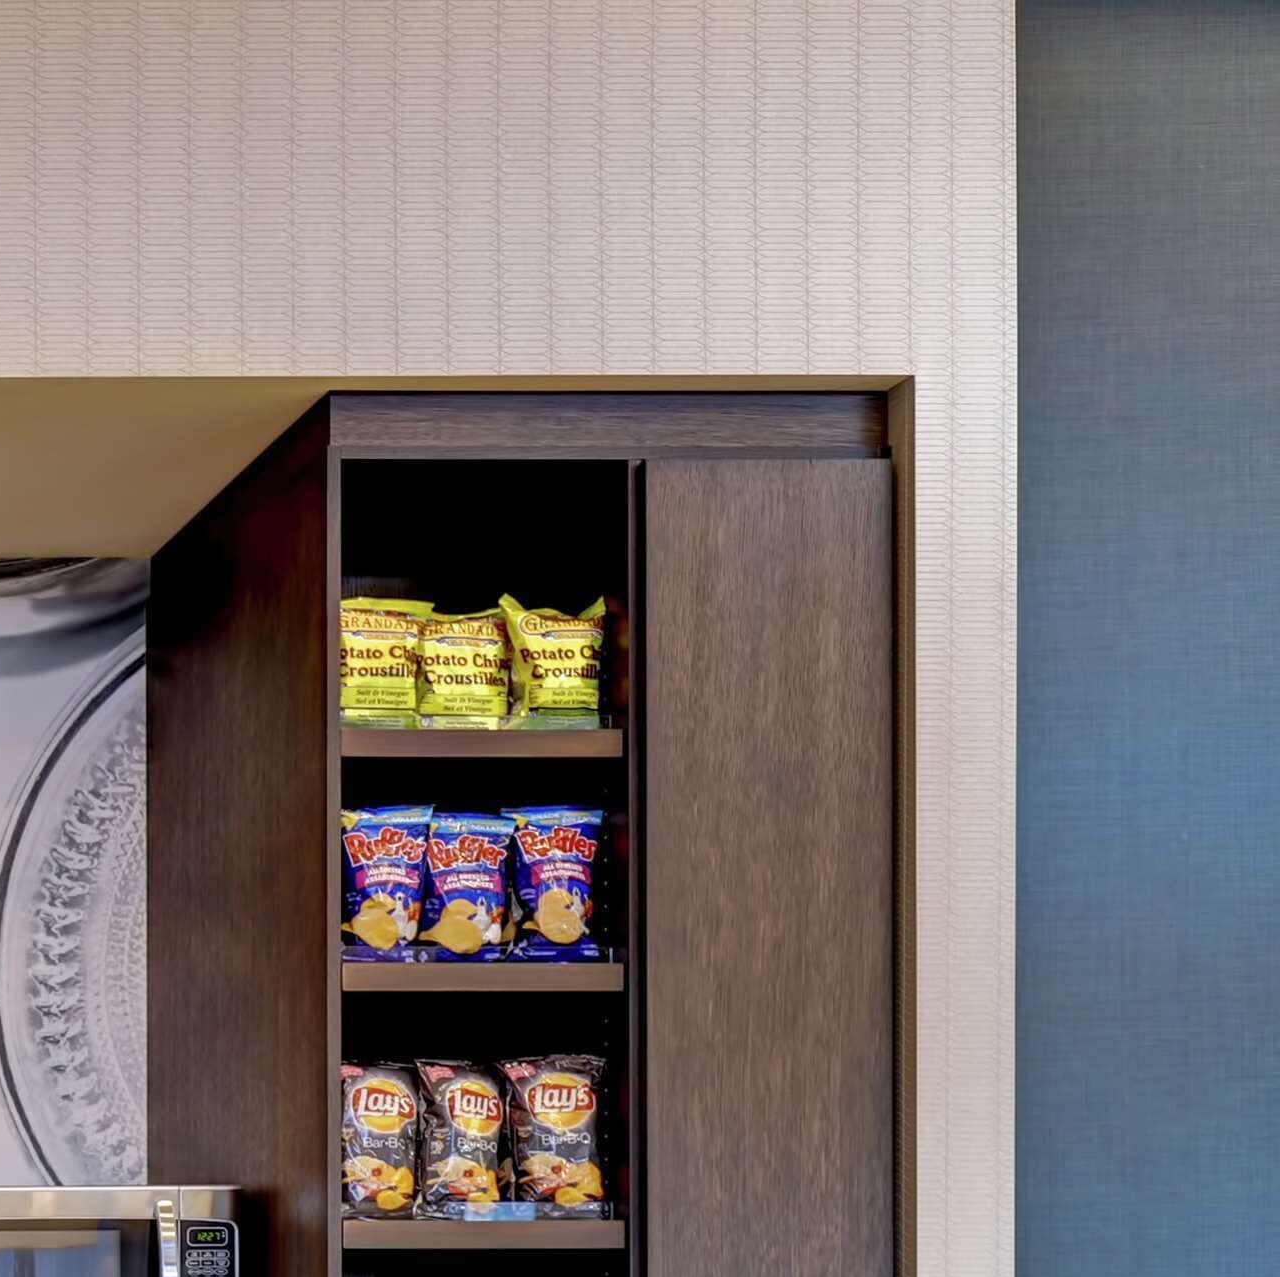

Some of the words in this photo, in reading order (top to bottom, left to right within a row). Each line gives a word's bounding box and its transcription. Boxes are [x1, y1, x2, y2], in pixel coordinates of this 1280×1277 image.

[340, 646, 384, 660] otato
[520, 647, 576, 663] Potato
[357, 1087, 411, 1117] Lay's
[454, 1088, 498, 1119] Lay's
[534, 1082, 591, 1113] Lay's
